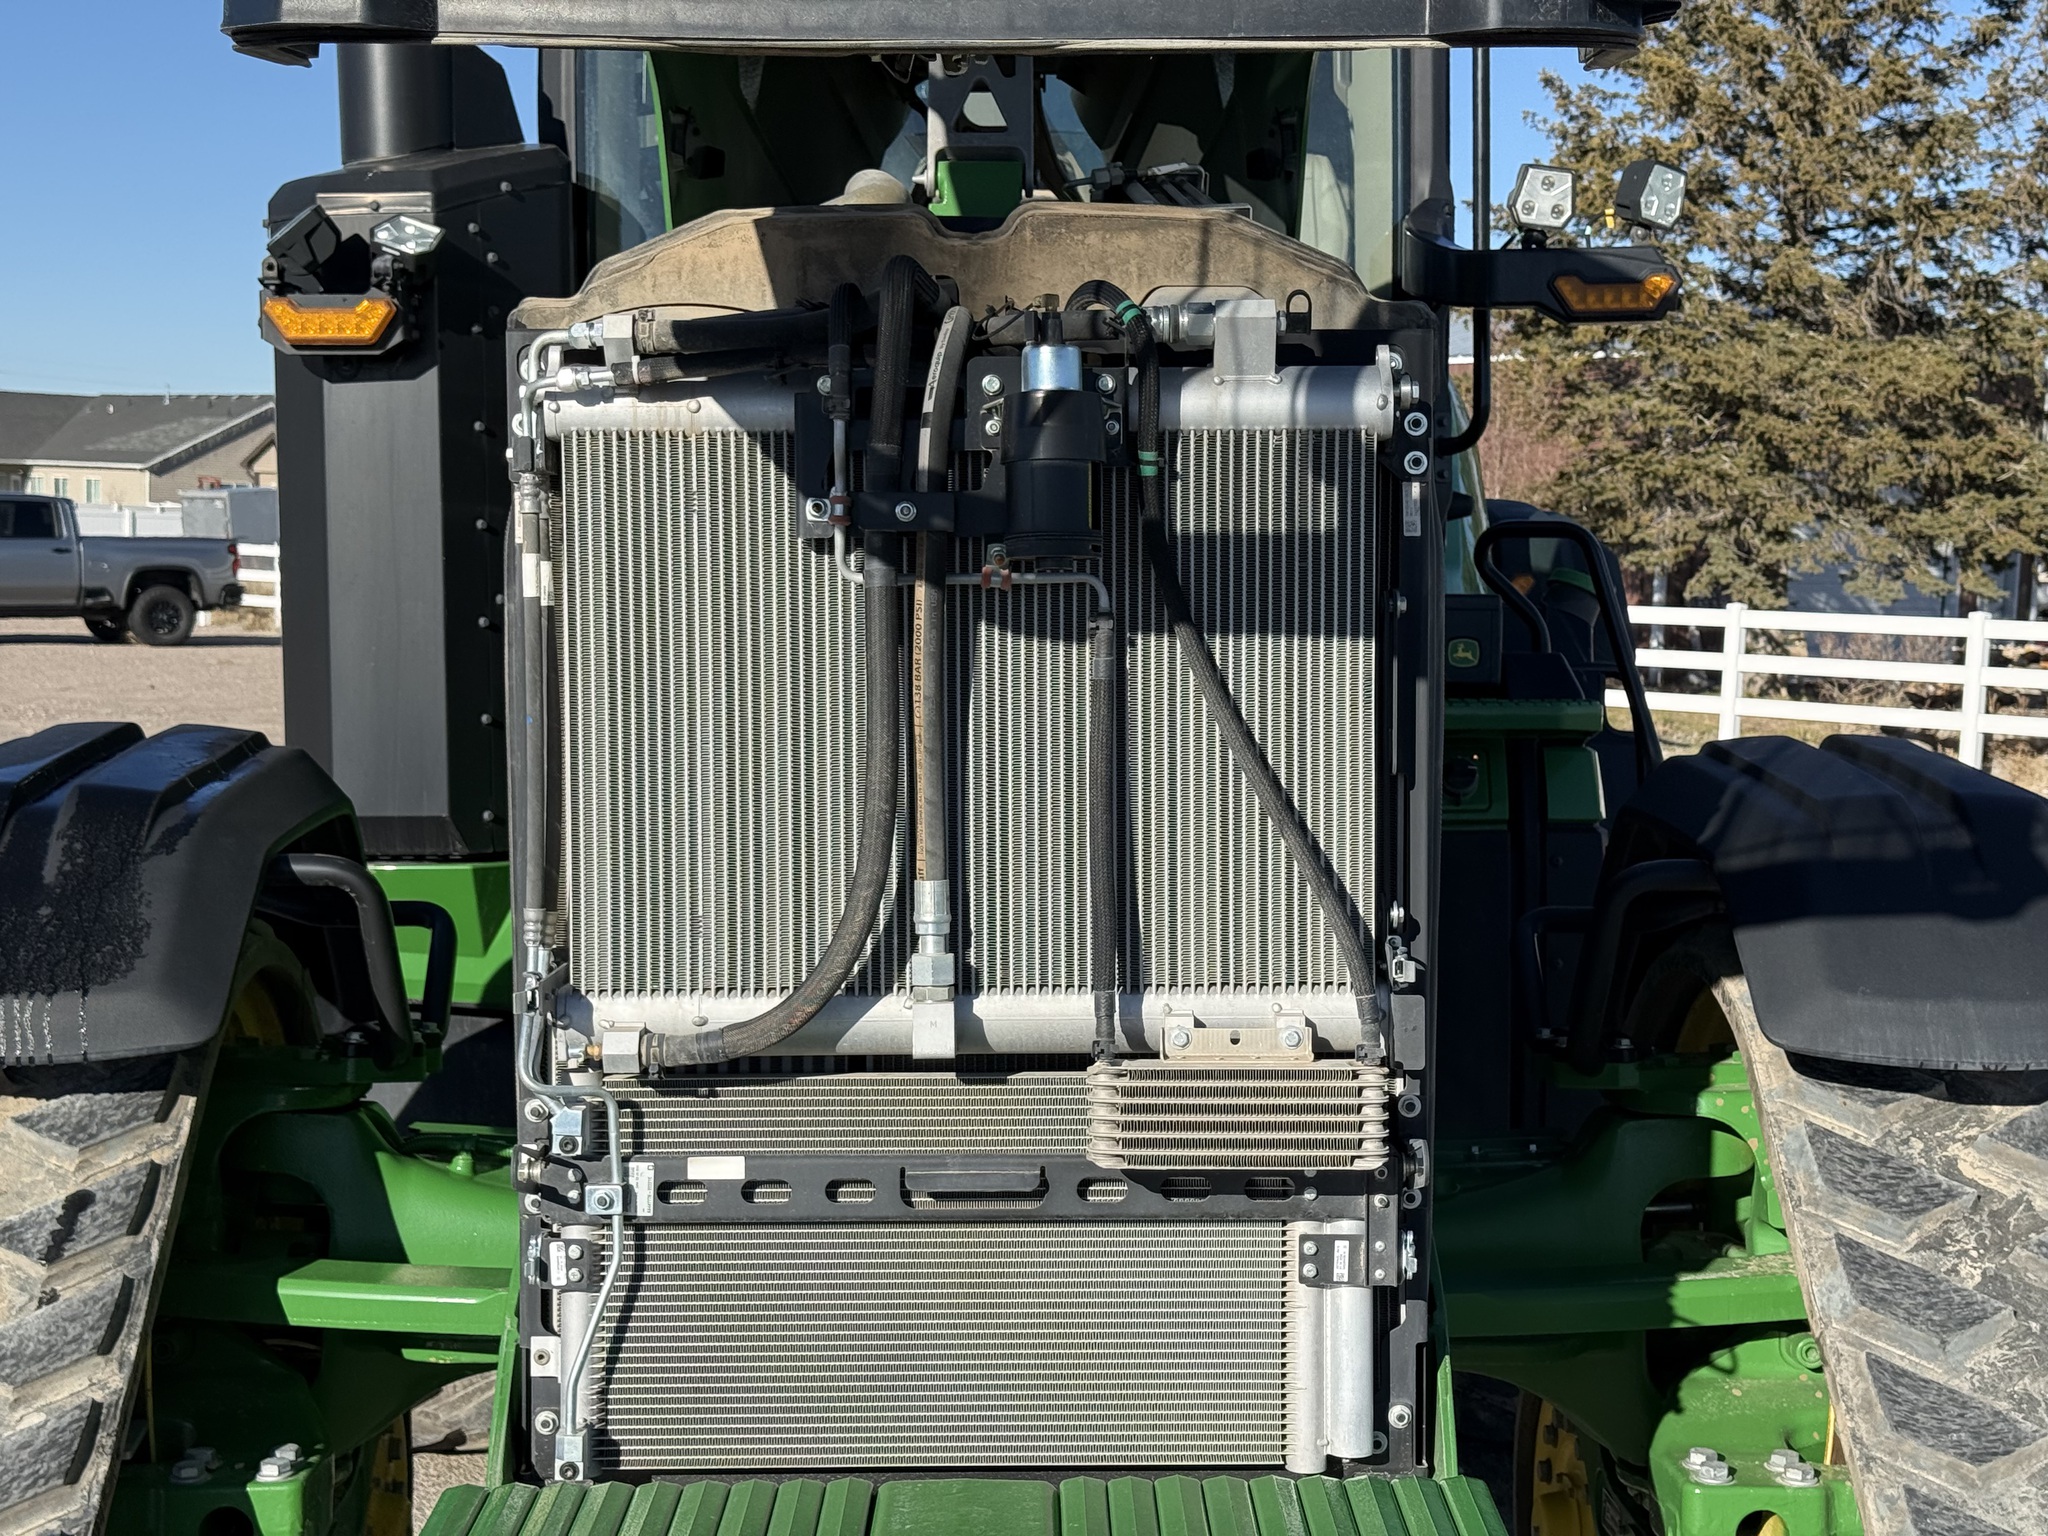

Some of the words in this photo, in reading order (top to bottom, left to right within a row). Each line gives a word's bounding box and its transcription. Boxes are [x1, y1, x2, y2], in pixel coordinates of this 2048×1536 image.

[928, 351, 942, 388] Aeroquip
[930, 589, 938, 607] USA
[915, 599, 923, 621] PSI)
